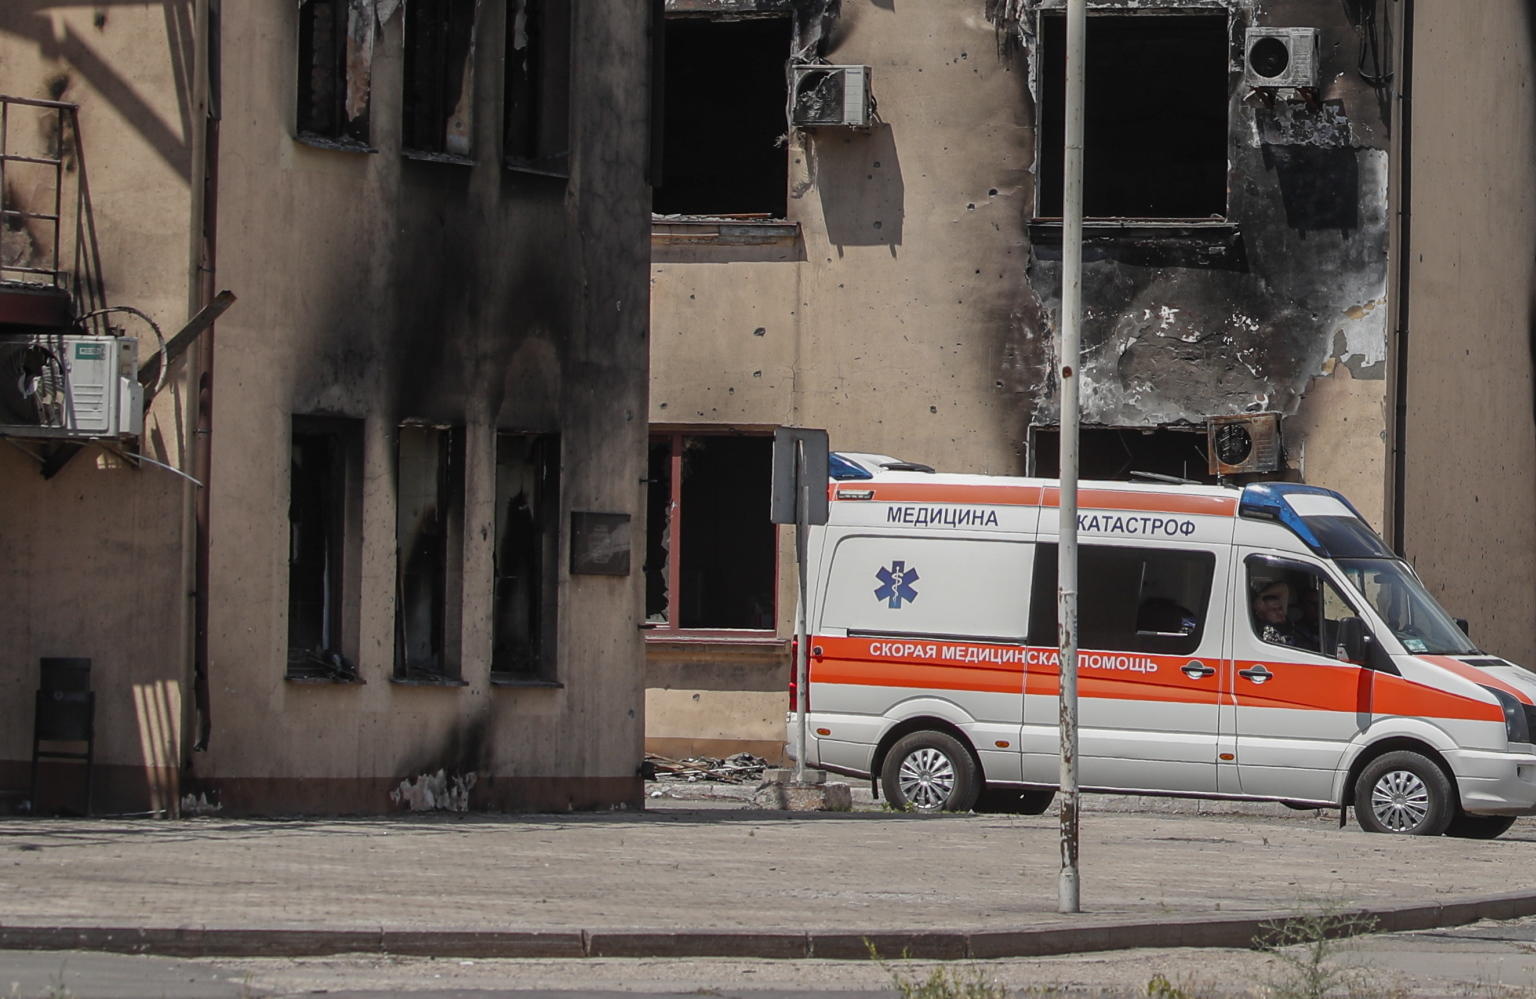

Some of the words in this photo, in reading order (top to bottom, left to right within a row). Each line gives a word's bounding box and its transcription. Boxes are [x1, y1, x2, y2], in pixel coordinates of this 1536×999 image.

[887, 506, 999, 528] МЕДИЦИНА
[1077, 514, 1196, 537] КАТАСТРОФ
[870, 642, 937, 659] СКОРАЯ
[941, 645, 1062, 666] МЕДИЦИНСКА
[1077, 654, 1158, 675] ПОМОЩЬ
